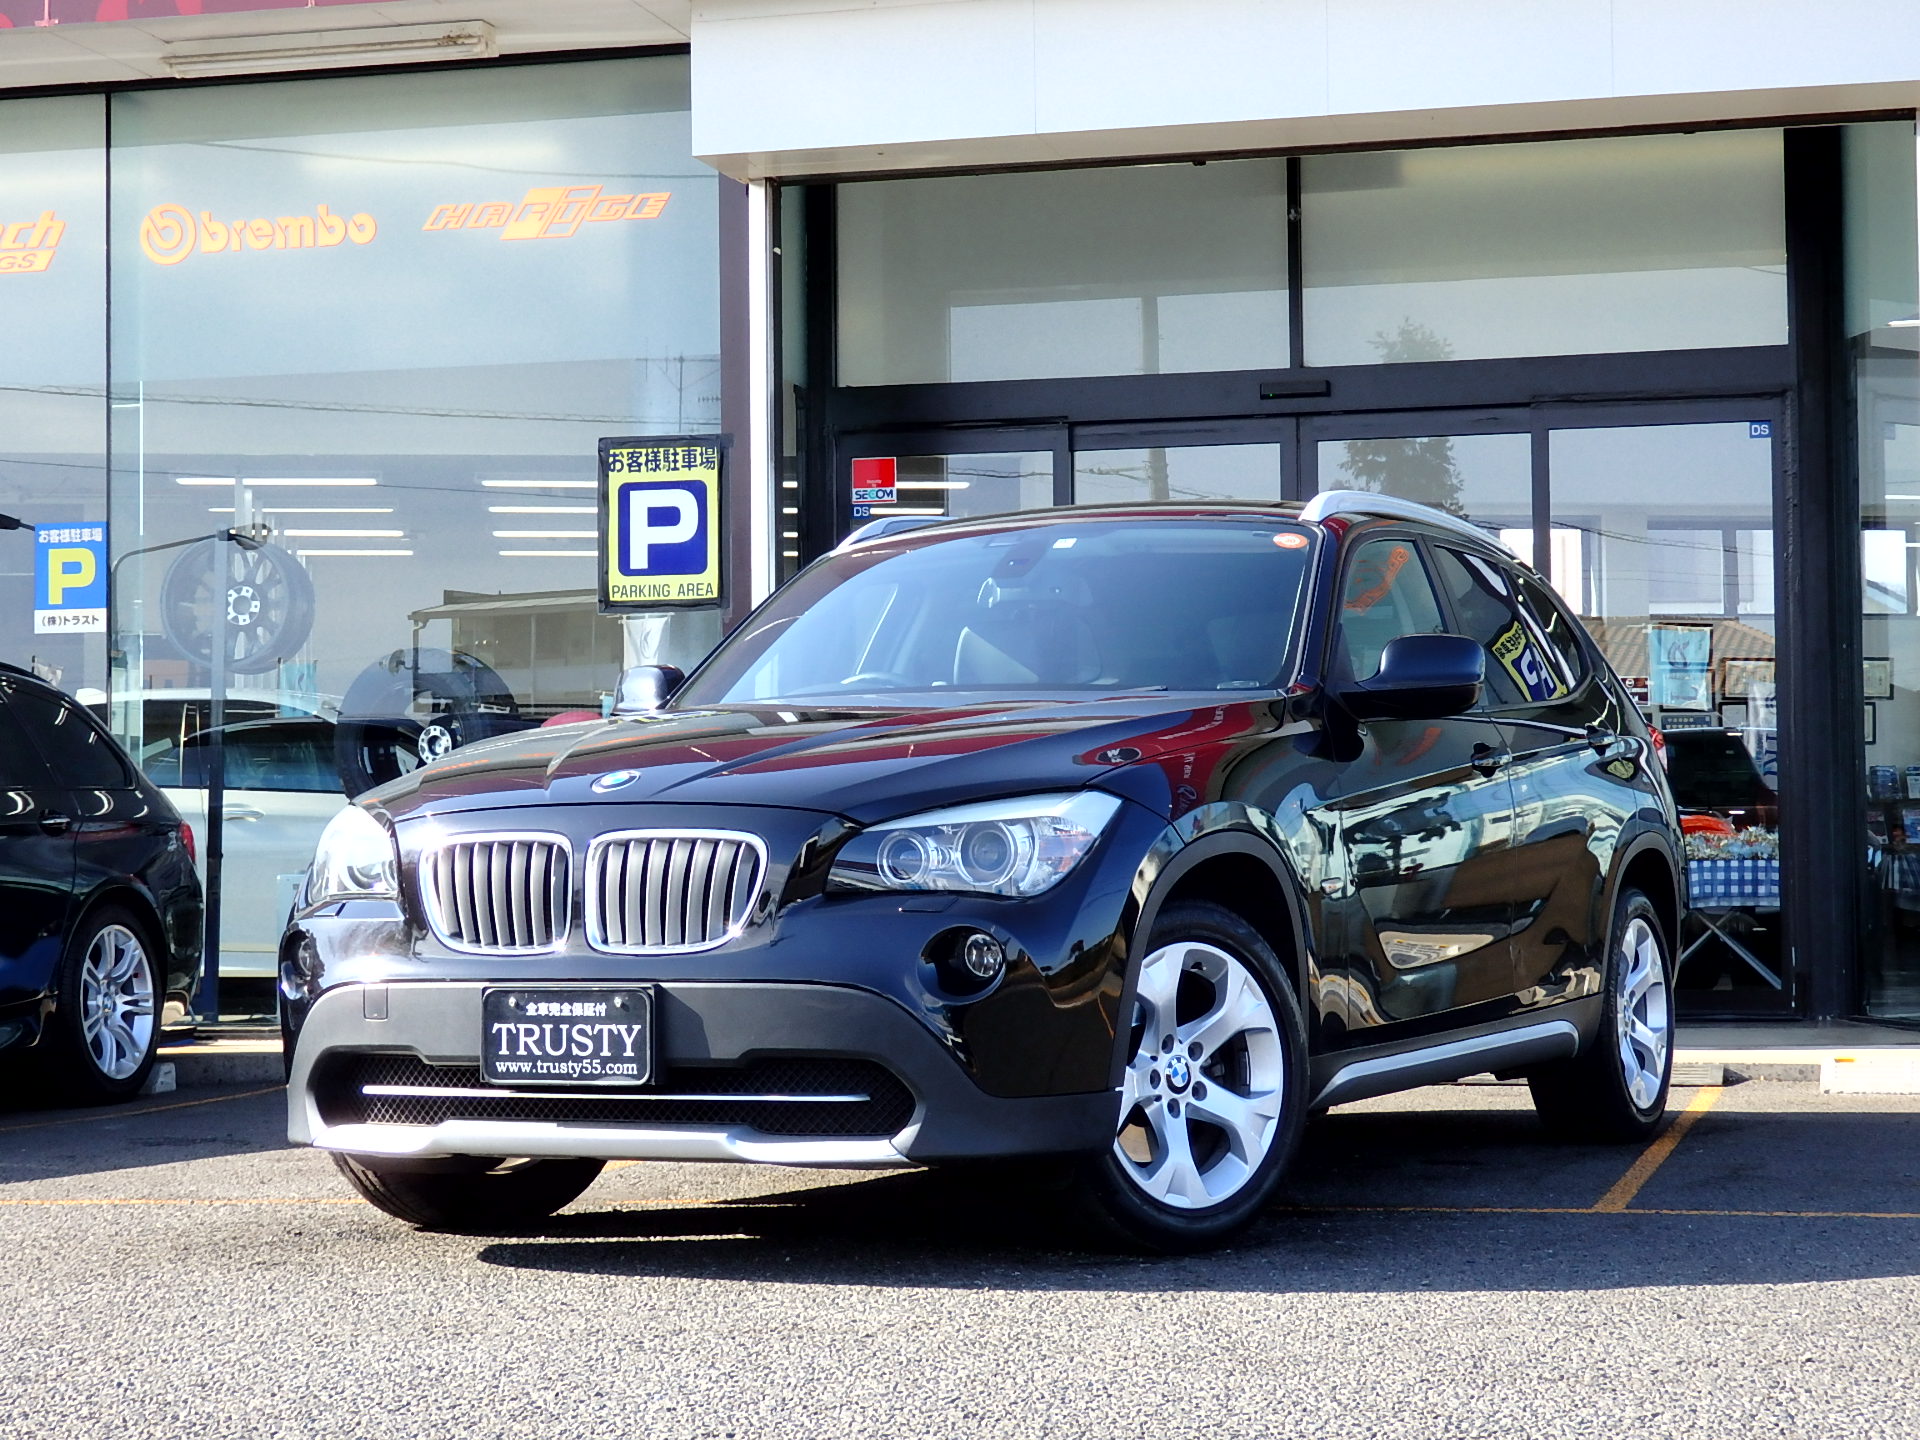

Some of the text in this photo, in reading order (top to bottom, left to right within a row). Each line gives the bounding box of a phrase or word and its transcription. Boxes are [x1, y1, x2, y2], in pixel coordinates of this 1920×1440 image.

[0, 210, 66, 250] ch
[199, 203, 377, 254] brembo
[1751, 424, 1769, 436] DS
[608, 446, 717, 473] お客様駐車場
[855, 489, 894, 500] SECOM
[853, 506, 870, 517] DS
[38, 527, 103, 543] お客様駐車場
[629, 488, 699, 570] P
[48, 547, 96, 605] P
[611, 582, 714, 599] PARKING AREA
[491, 1022, 642, 1057] TRUSTY
[495, 1058, 638, 1077] www.trusty55.com
